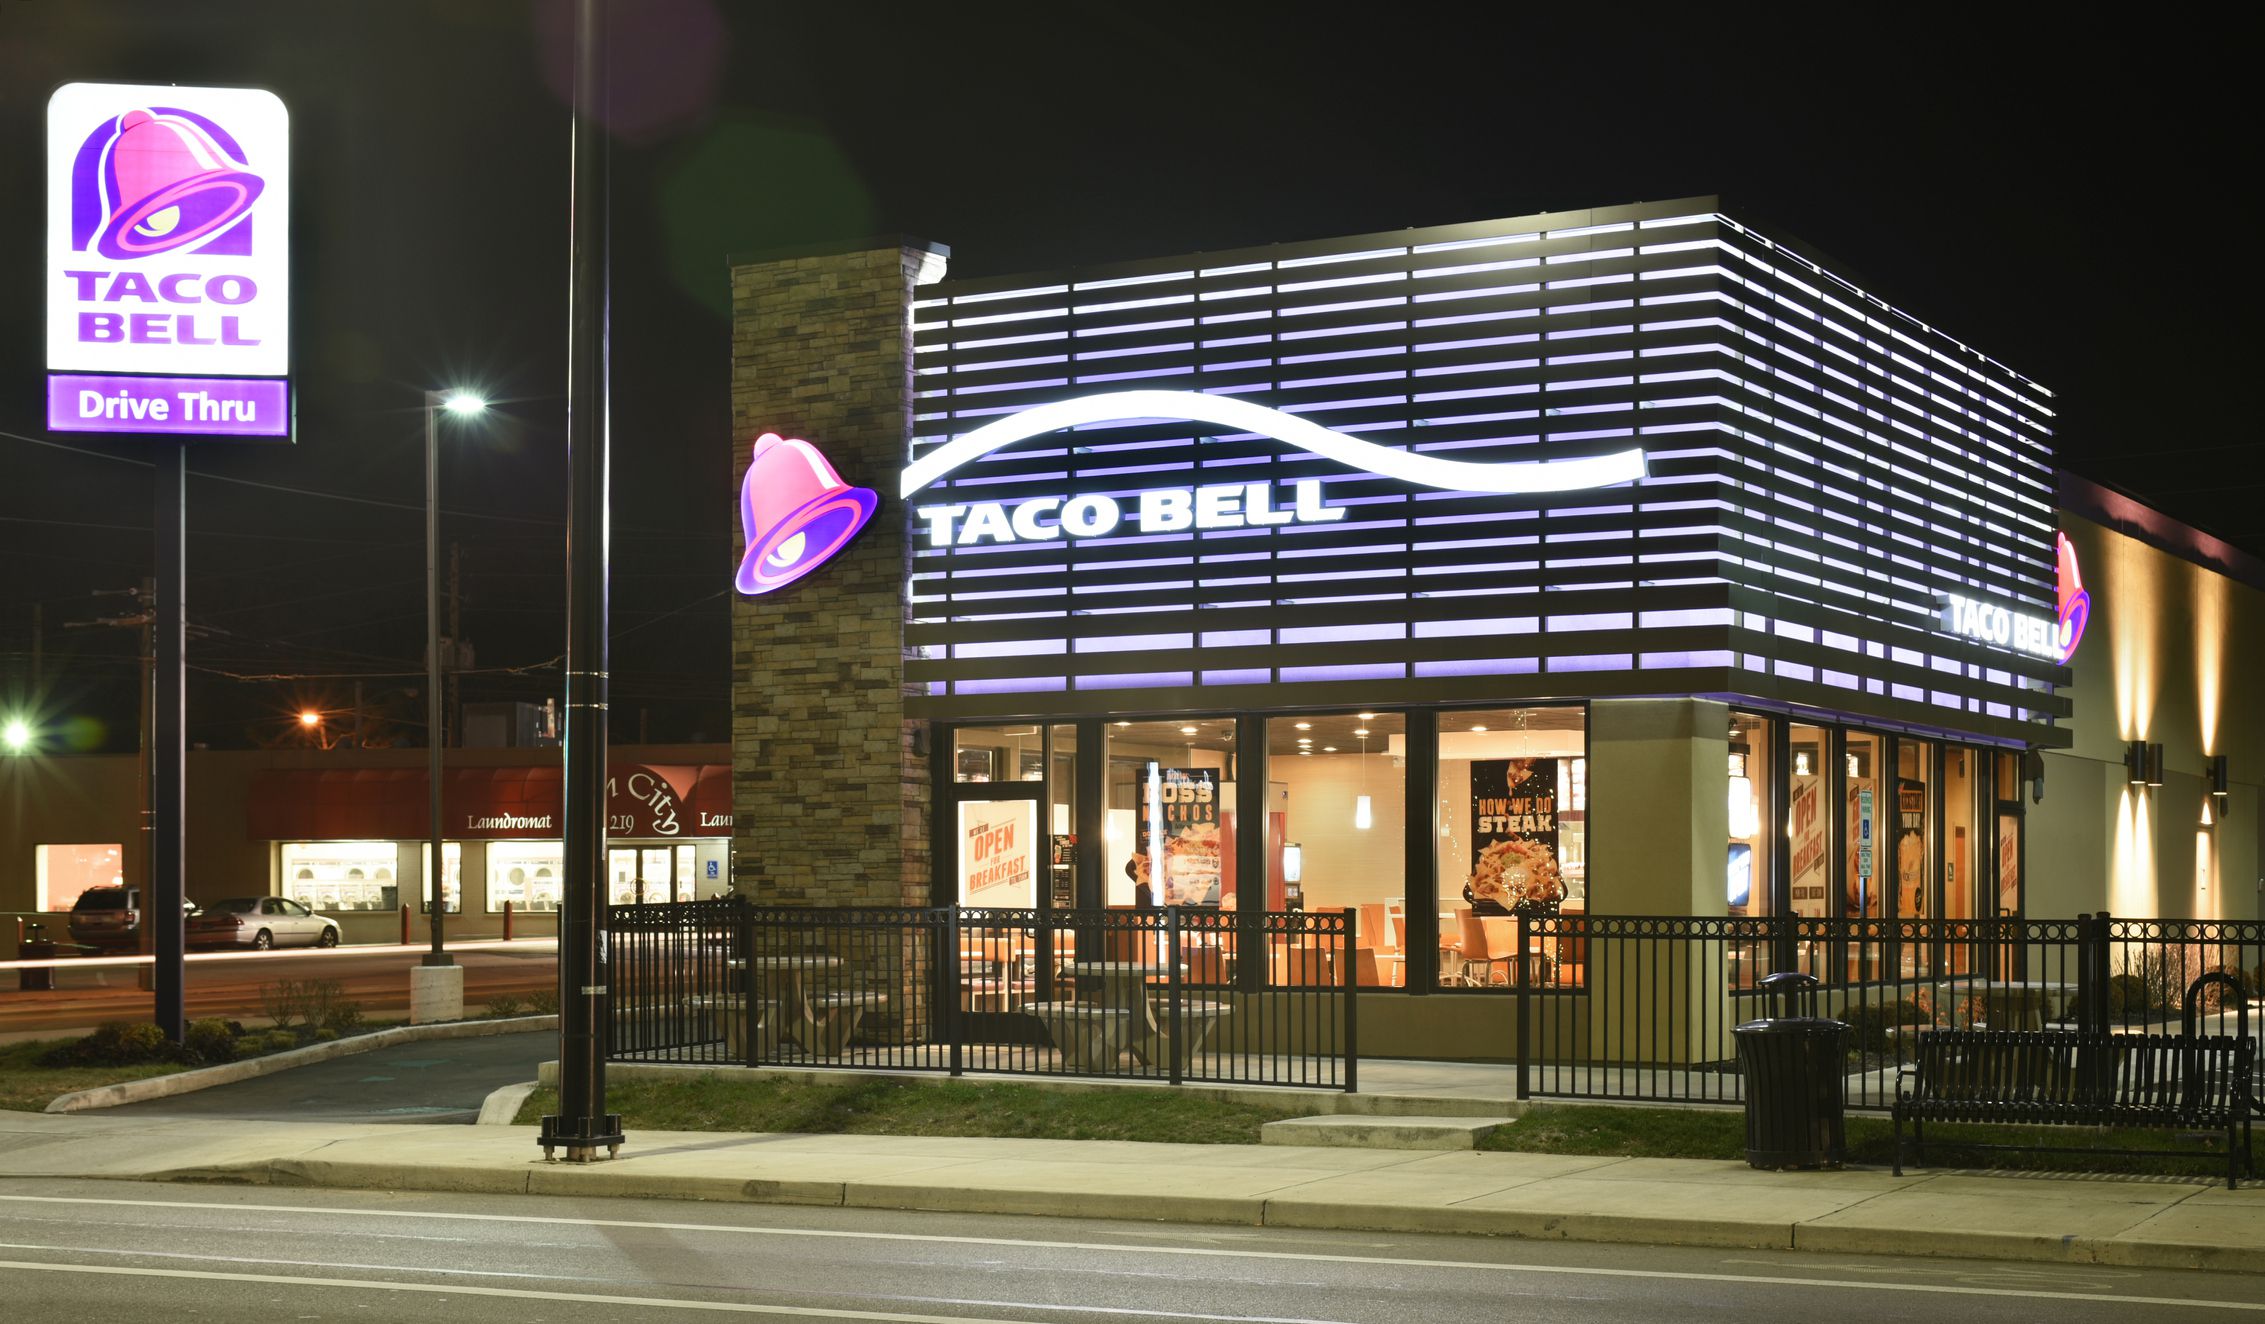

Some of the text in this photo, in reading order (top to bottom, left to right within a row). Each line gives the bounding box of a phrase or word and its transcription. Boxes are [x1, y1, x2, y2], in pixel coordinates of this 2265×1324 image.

[64, 270, 257, 304] TACO
[78, 312, 261, 345] BELL
[79, 390, 256, 421] Drive Thru
[917, 479, 1346, 546] TACO BELL
[1949, 593, 2009, 645] TACO
[467, 812, 552, 829] Laundromat
[628, 773, 680, 835] City
[1142, 804, 1212, 821] NCHOS
[1479, 796, 1552, 815] HOW WE DO
[1795, 786, 1817, 838] OPEN
[609, 815, 634, 834] 219
[1478, 814, 1552, 833] STEAK
[974, 823, 1014, 862] OPEN
[969, 855, 1025, 892] BREAKFAST
